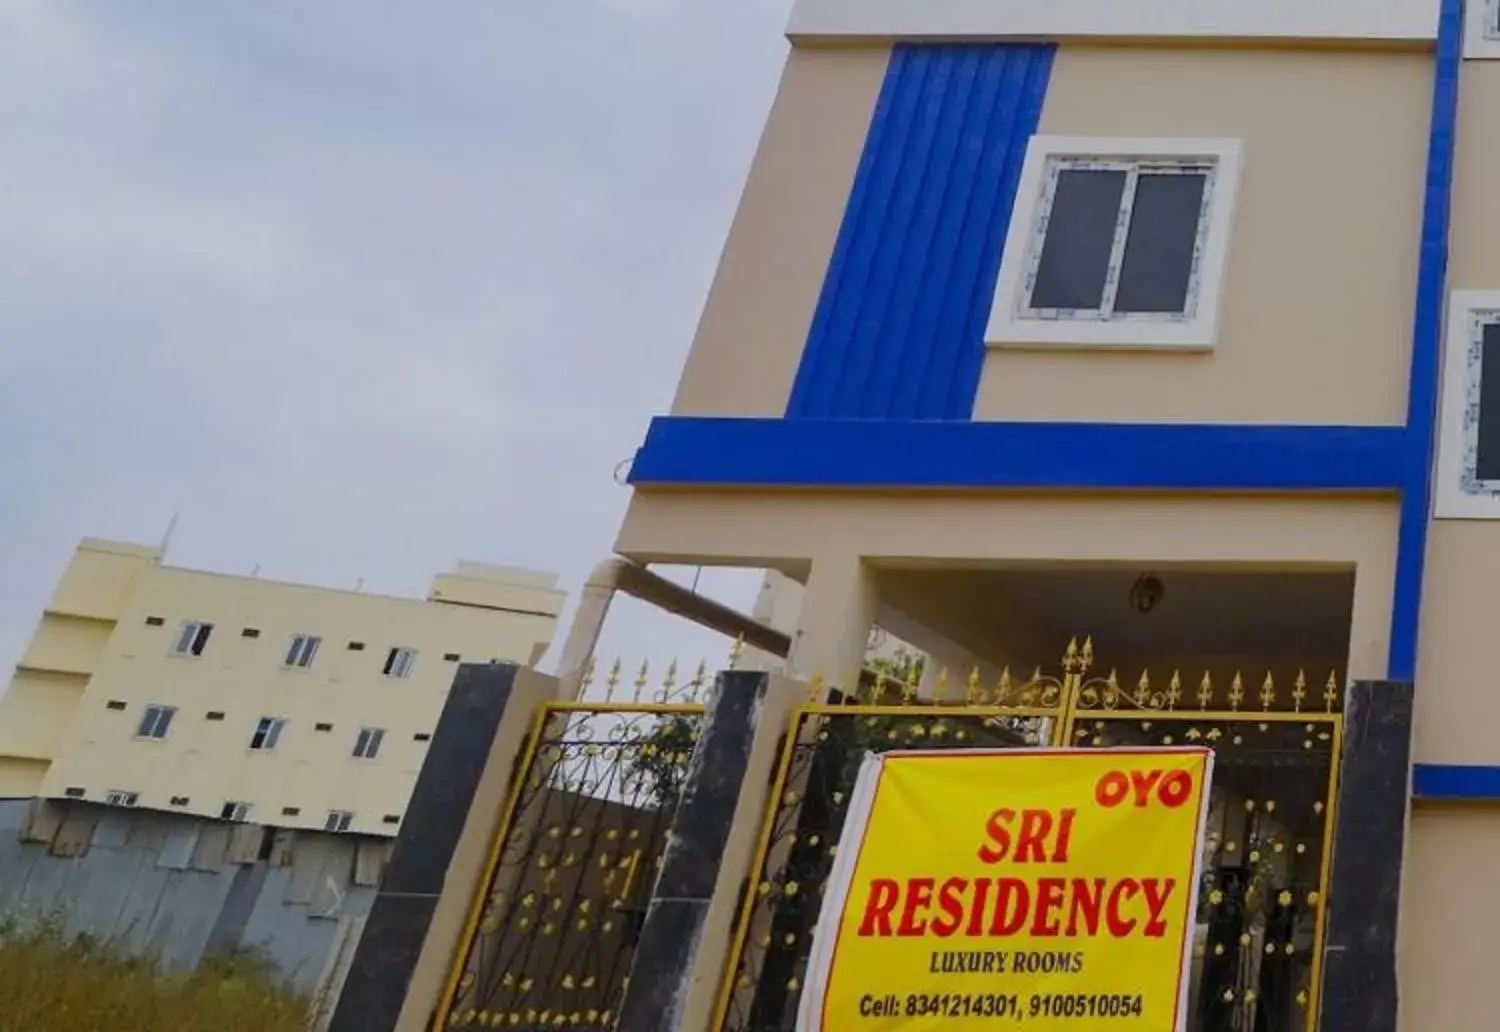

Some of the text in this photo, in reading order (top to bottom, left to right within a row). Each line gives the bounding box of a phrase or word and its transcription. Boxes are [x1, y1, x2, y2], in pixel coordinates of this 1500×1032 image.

[1095, 769, 1193, 807] OYO
[977, 809, 1076, 864] SRI
[857, 877, 1175, 937] RESIDENCY
[929, 951, 1083, 974] LUXURY ROOMS
[859, 993, 1142, 1020] Cell: 8341214301, 9100510054
